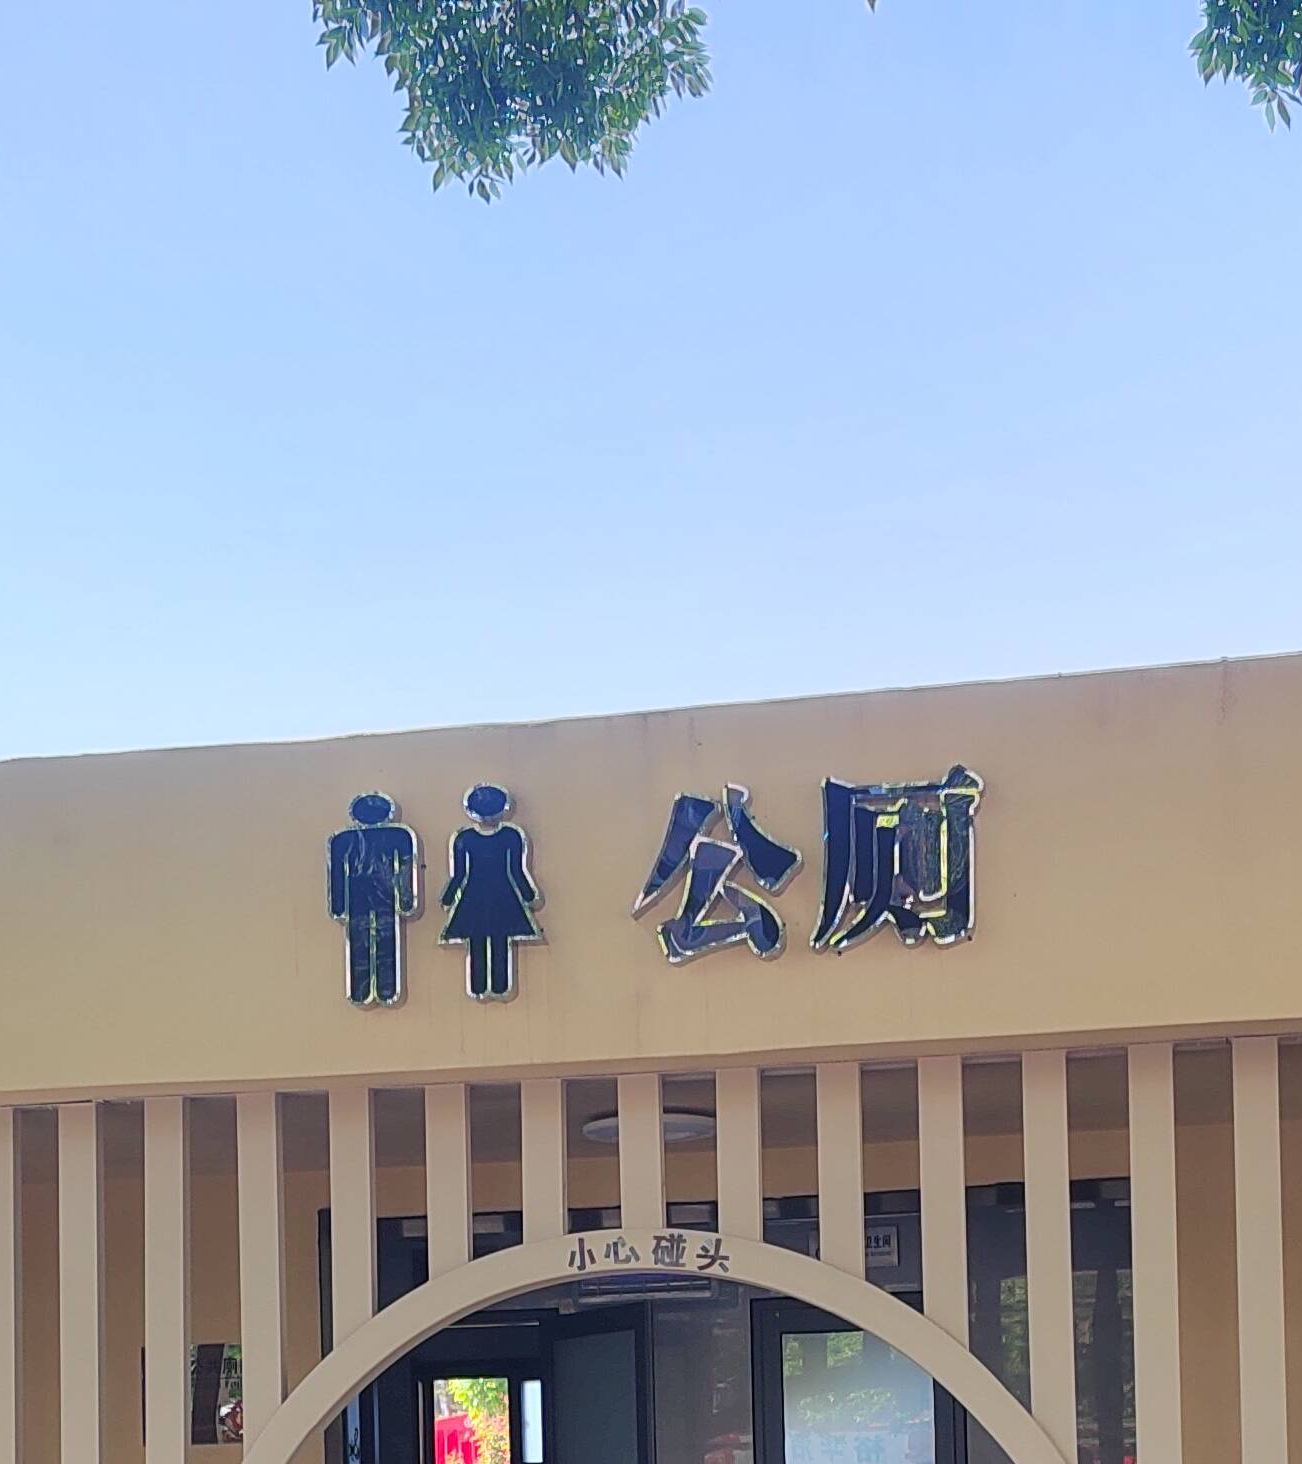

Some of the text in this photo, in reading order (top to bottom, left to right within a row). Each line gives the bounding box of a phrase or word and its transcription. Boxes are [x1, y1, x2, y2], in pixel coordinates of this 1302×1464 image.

[633, 764, 984, 963] 公厕
[568, 1232, 730, 1273] 小心碰头
